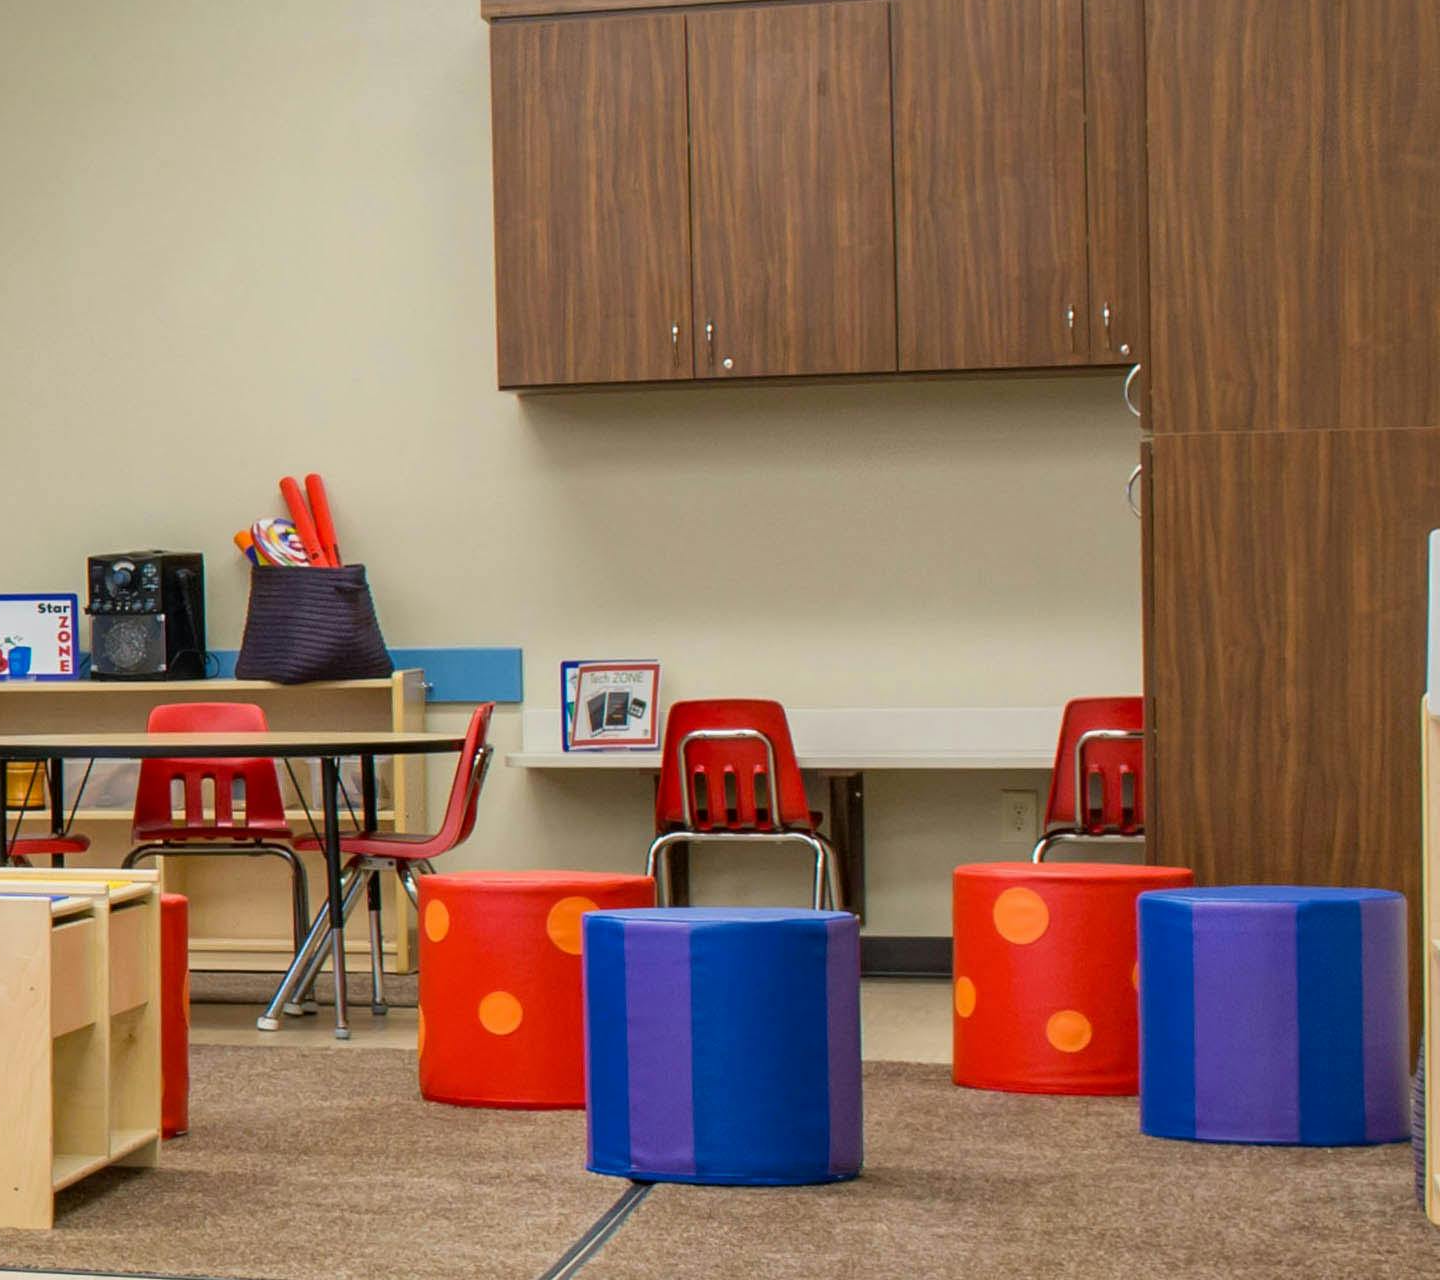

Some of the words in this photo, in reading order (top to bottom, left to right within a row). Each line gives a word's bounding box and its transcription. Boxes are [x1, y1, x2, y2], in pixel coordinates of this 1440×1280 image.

[37, 602, 71, 614] Star
[57, 615, 71, 673] ZONE
[589, 672, 610, 684] Tech
[612, 671, 644, 684] ZONE
